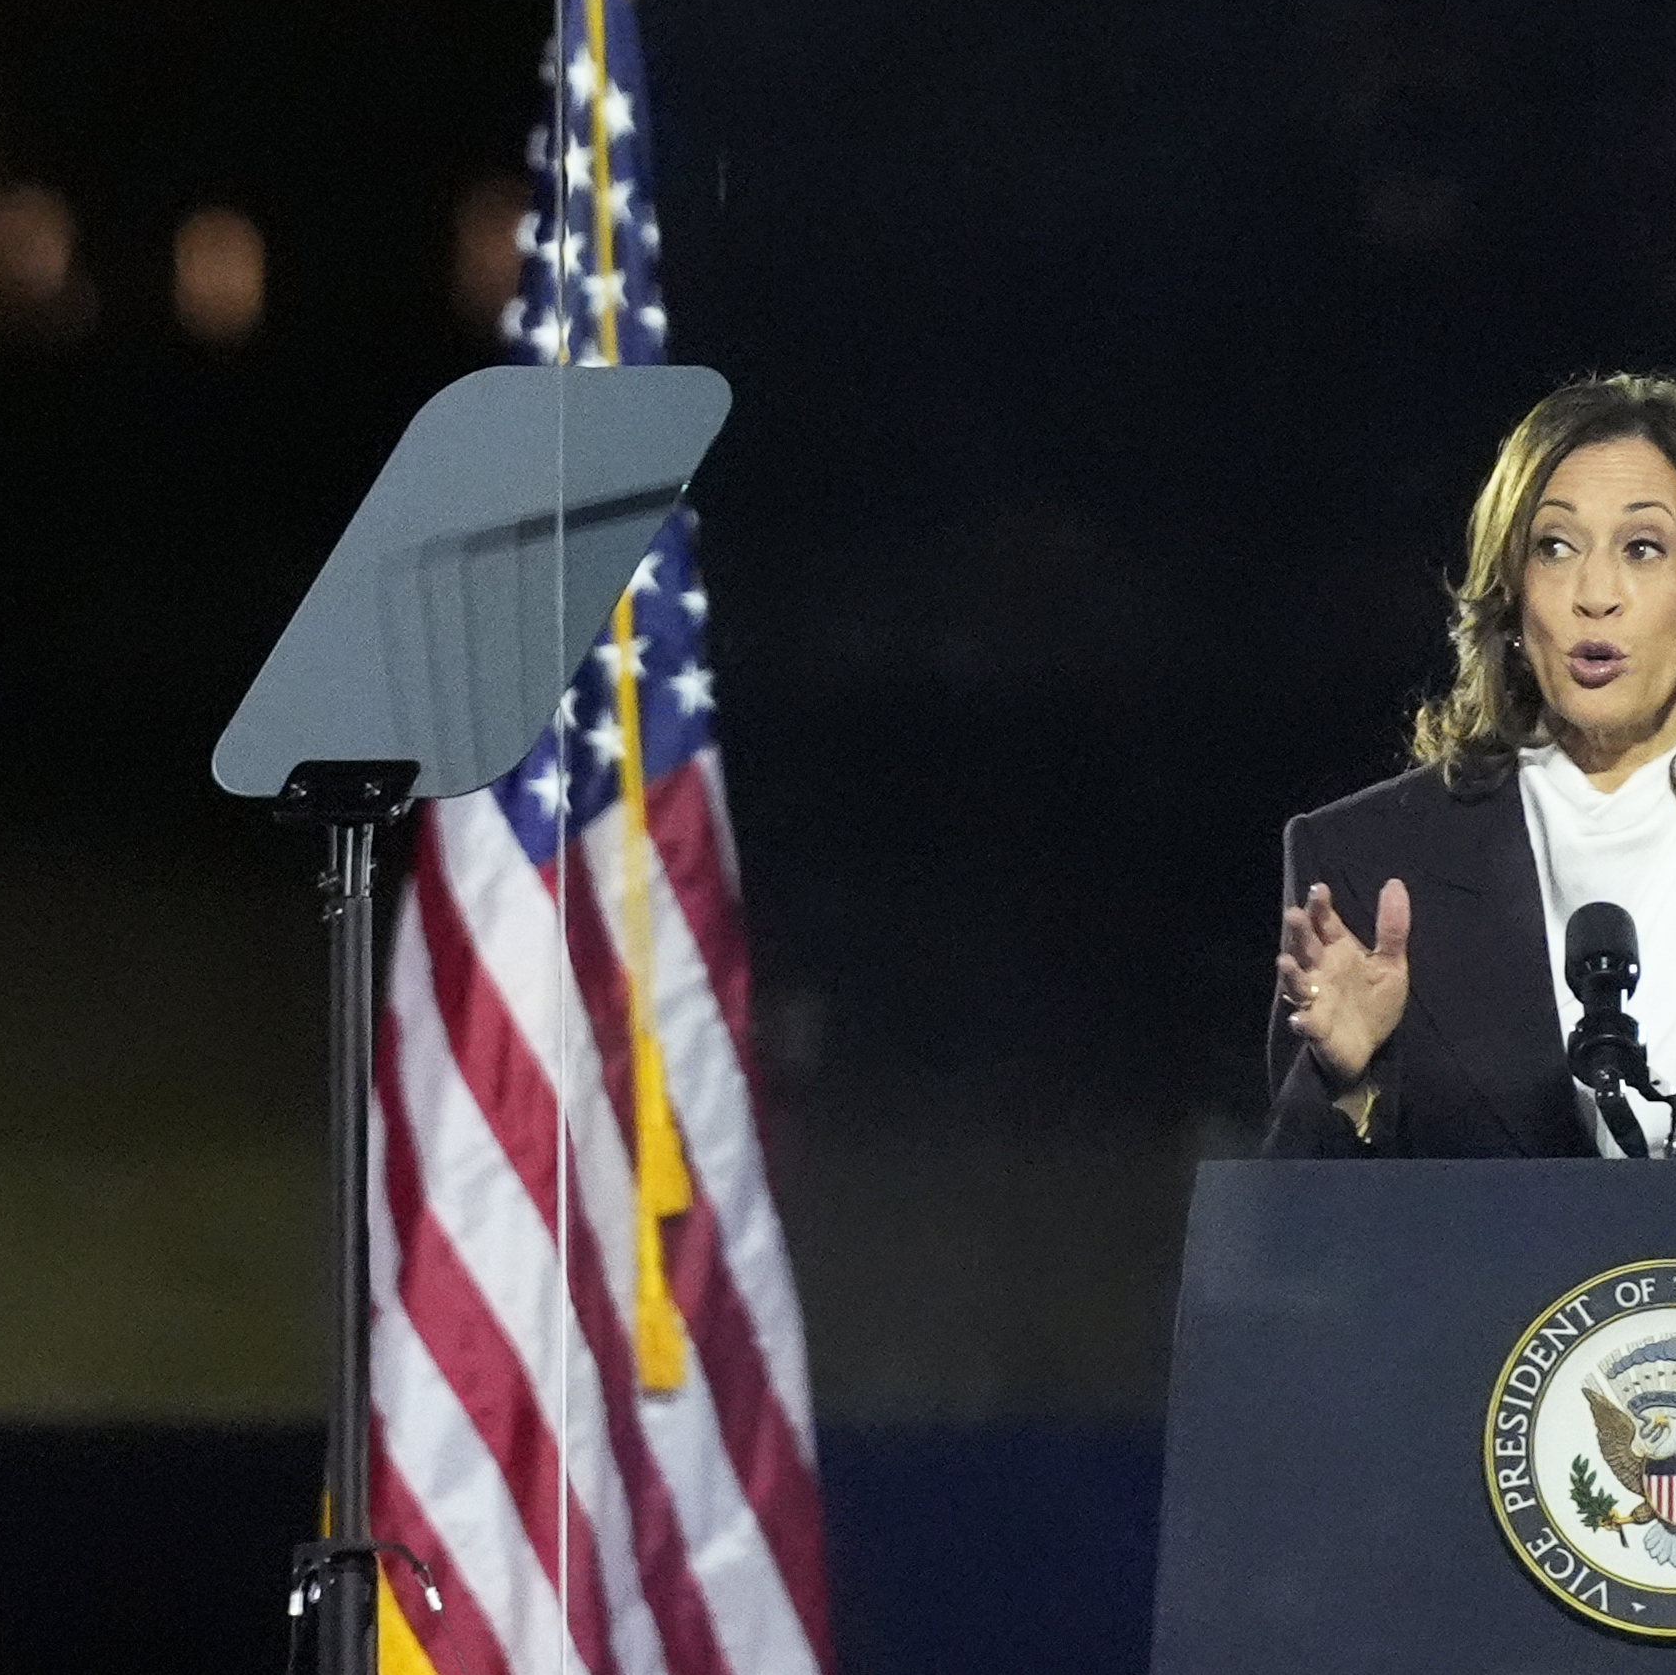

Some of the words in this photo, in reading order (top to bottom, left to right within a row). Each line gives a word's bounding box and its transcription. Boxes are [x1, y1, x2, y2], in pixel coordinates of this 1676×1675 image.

[1615, 1278, 1656, 1308] OF
[1496, 1295, 1595, 1512] PRESIDENT
[1525, 1528, 1609, 1612] VICE
